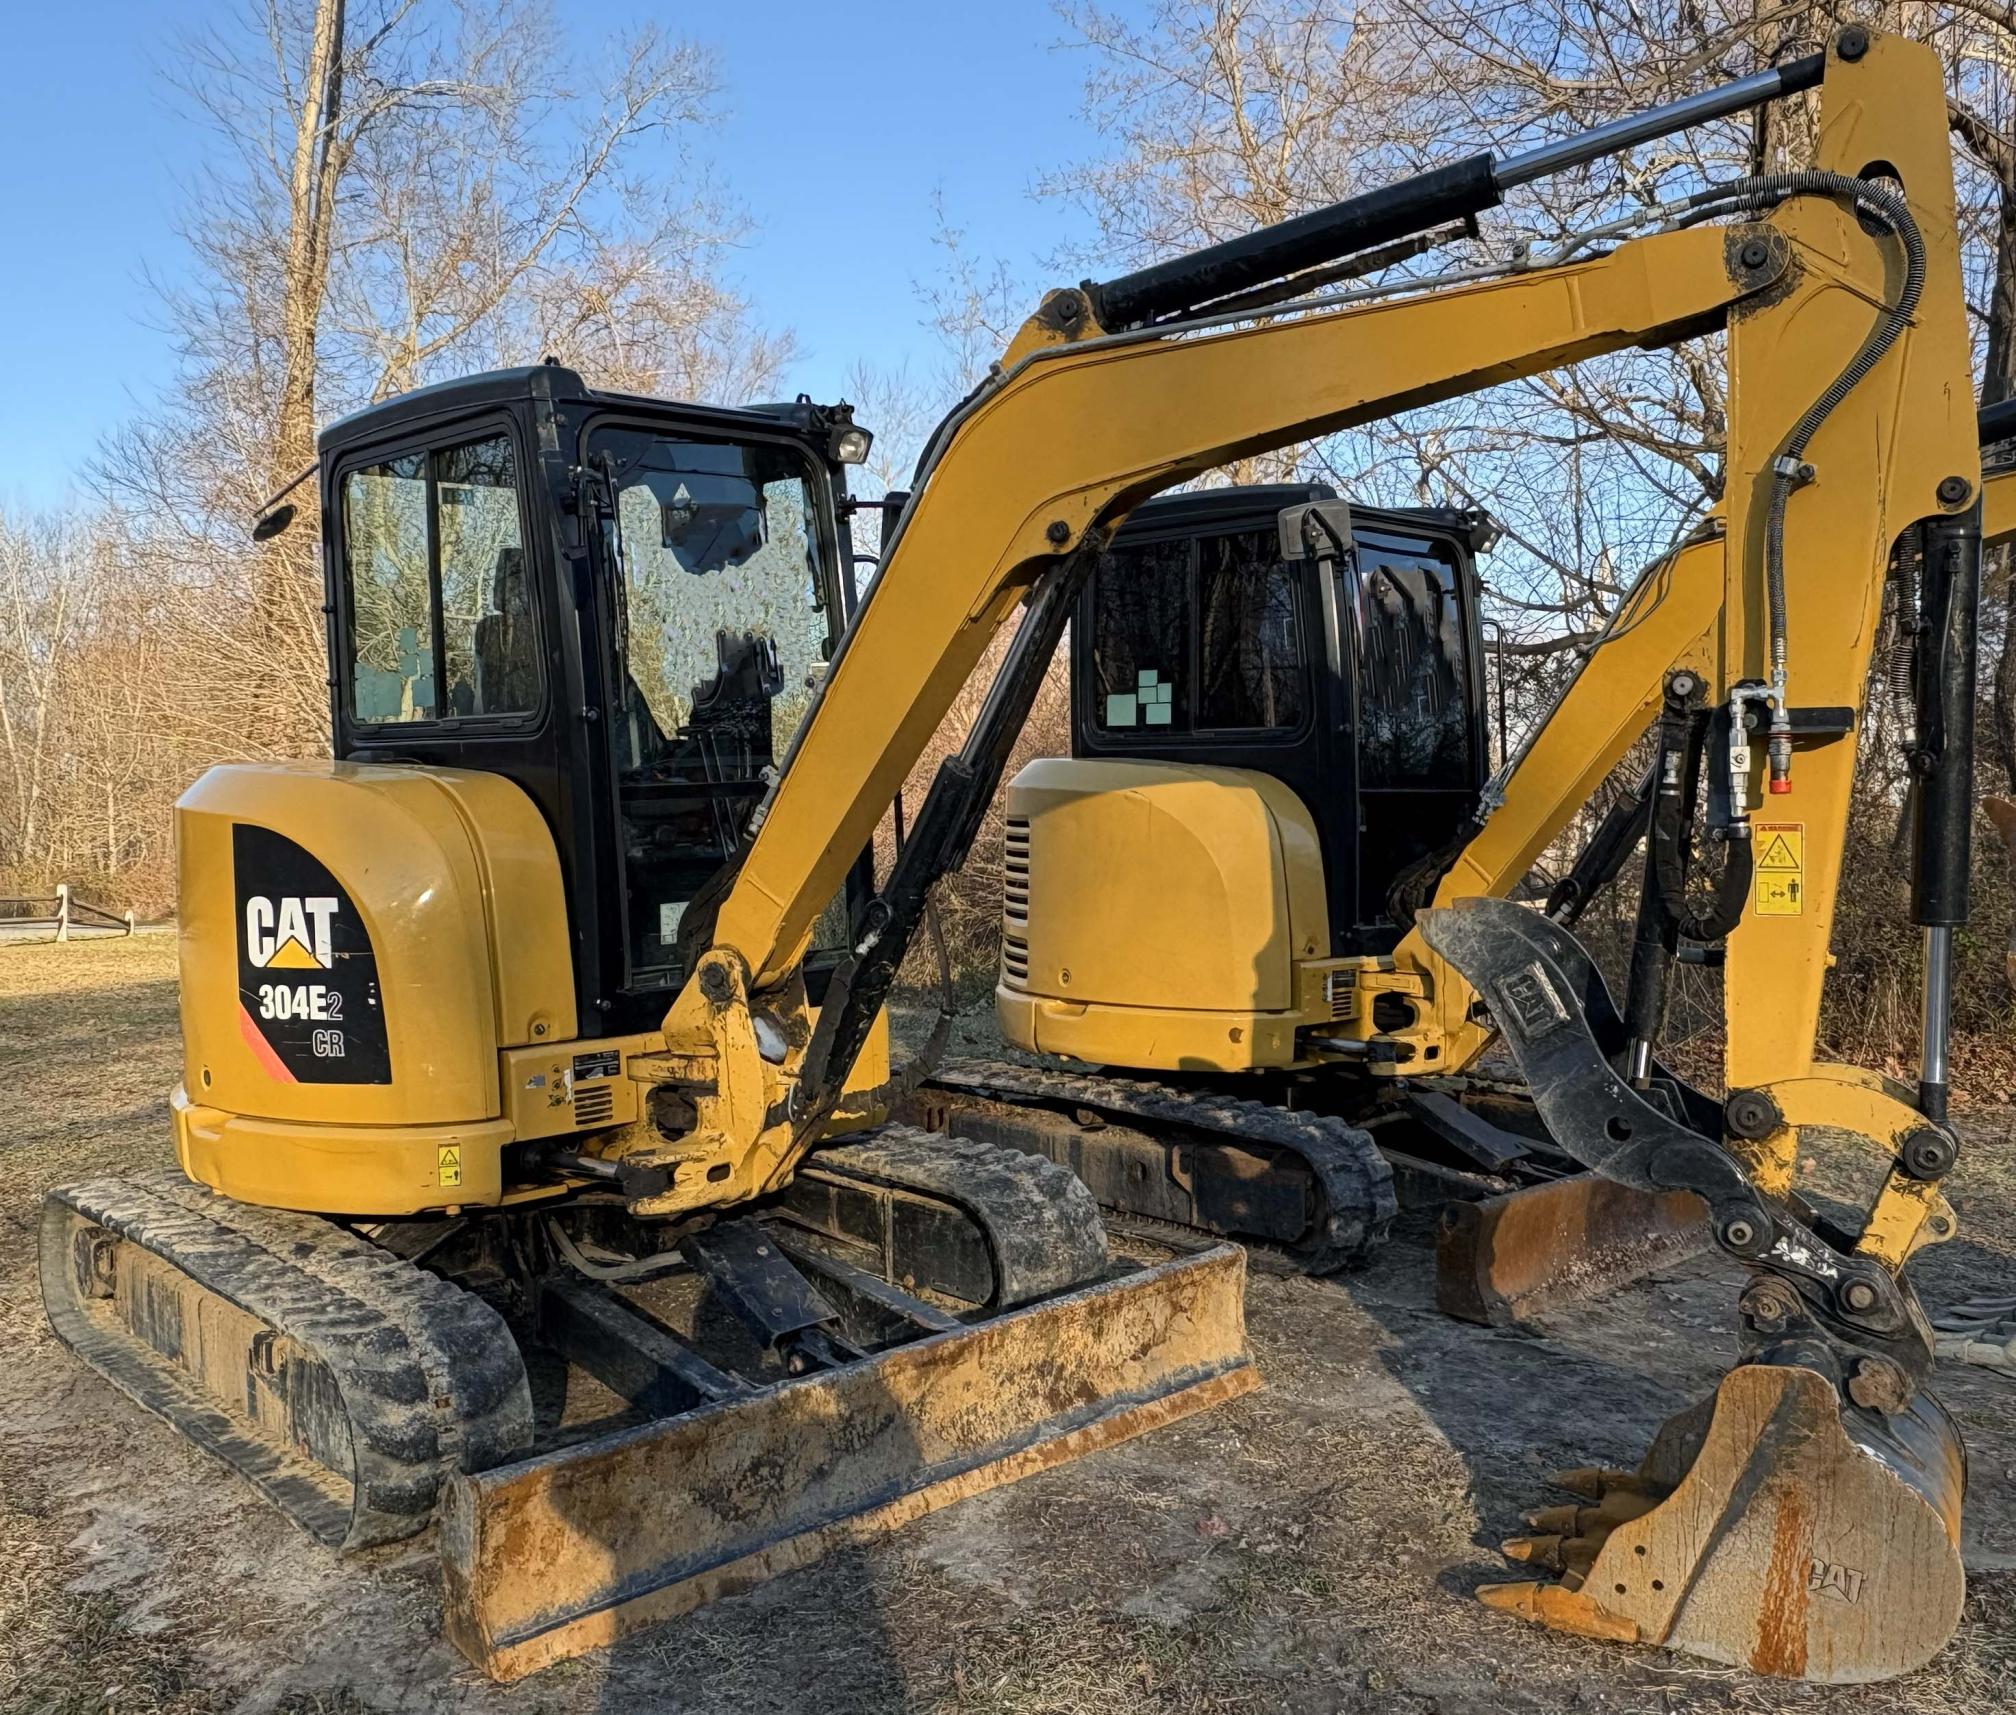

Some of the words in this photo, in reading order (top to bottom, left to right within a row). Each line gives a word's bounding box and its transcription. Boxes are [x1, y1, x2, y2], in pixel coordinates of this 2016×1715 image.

[246, 895, 339, 969] CAT
[259, 983, 343, 1021] 304E2
[312, 1028, 345, 1058] CR
[1807, 1556, 1868, 1606] CAT
